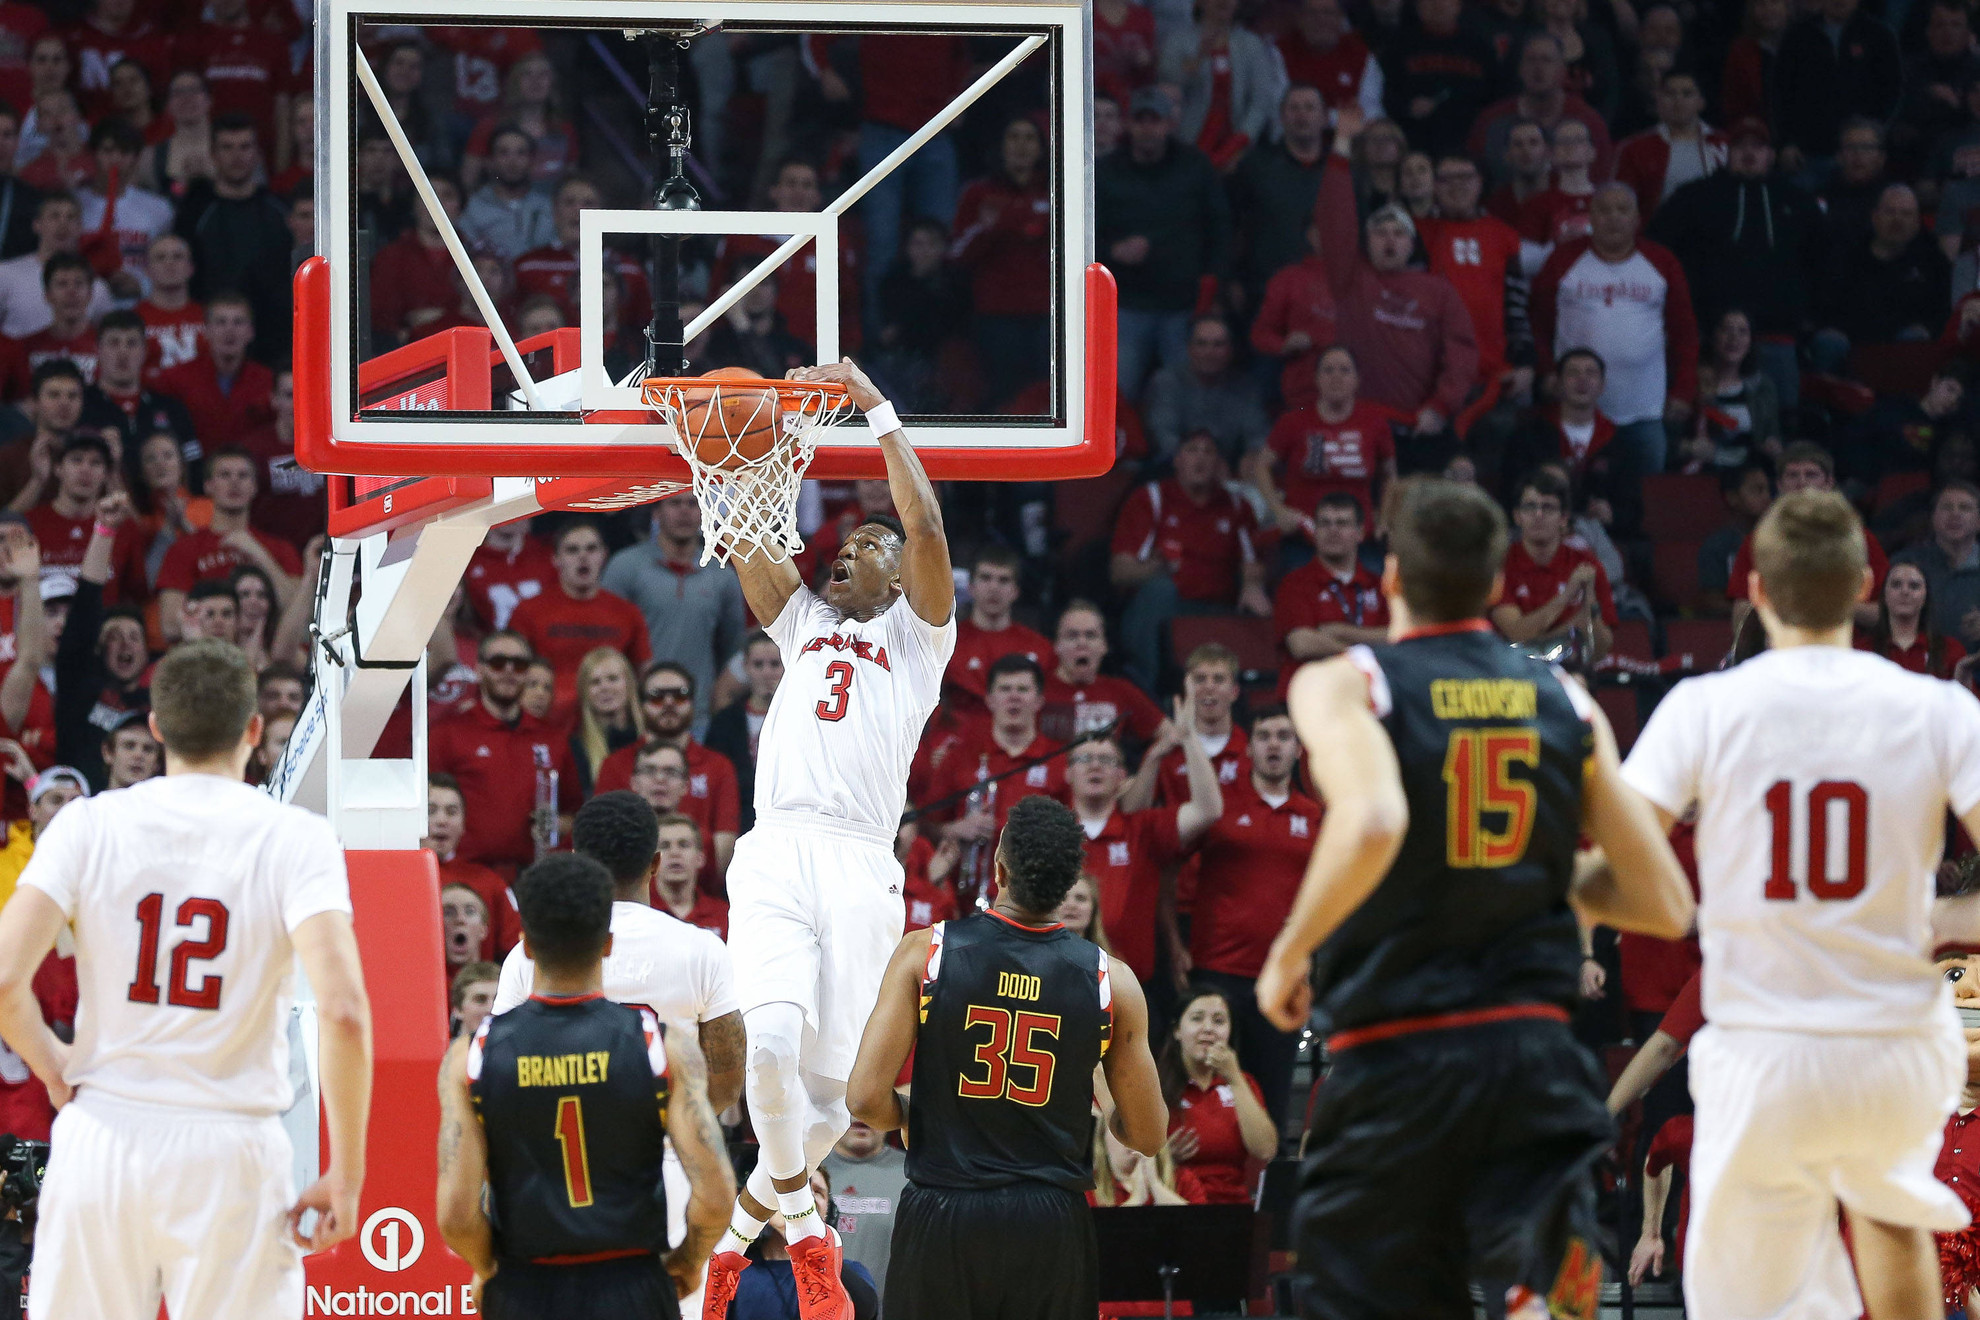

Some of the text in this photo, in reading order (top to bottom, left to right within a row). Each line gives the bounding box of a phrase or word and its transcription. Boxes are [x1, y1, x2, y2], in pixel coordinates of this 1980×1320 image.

[814, 660, 855, 723] 3
[1441, 726, 1541, 869] 15
[1763, 778, 1869, 901] 10
[128, 892, 229, 1010] 12
[996, 970, 1042, 1002] DODD
[516, 1050, 611, 1088] BRANTLEY
[957, 1004, 1062, 1107] 35
[554, 1095, 594, 1209] 1
[306, 1284, 453, 1317] National
